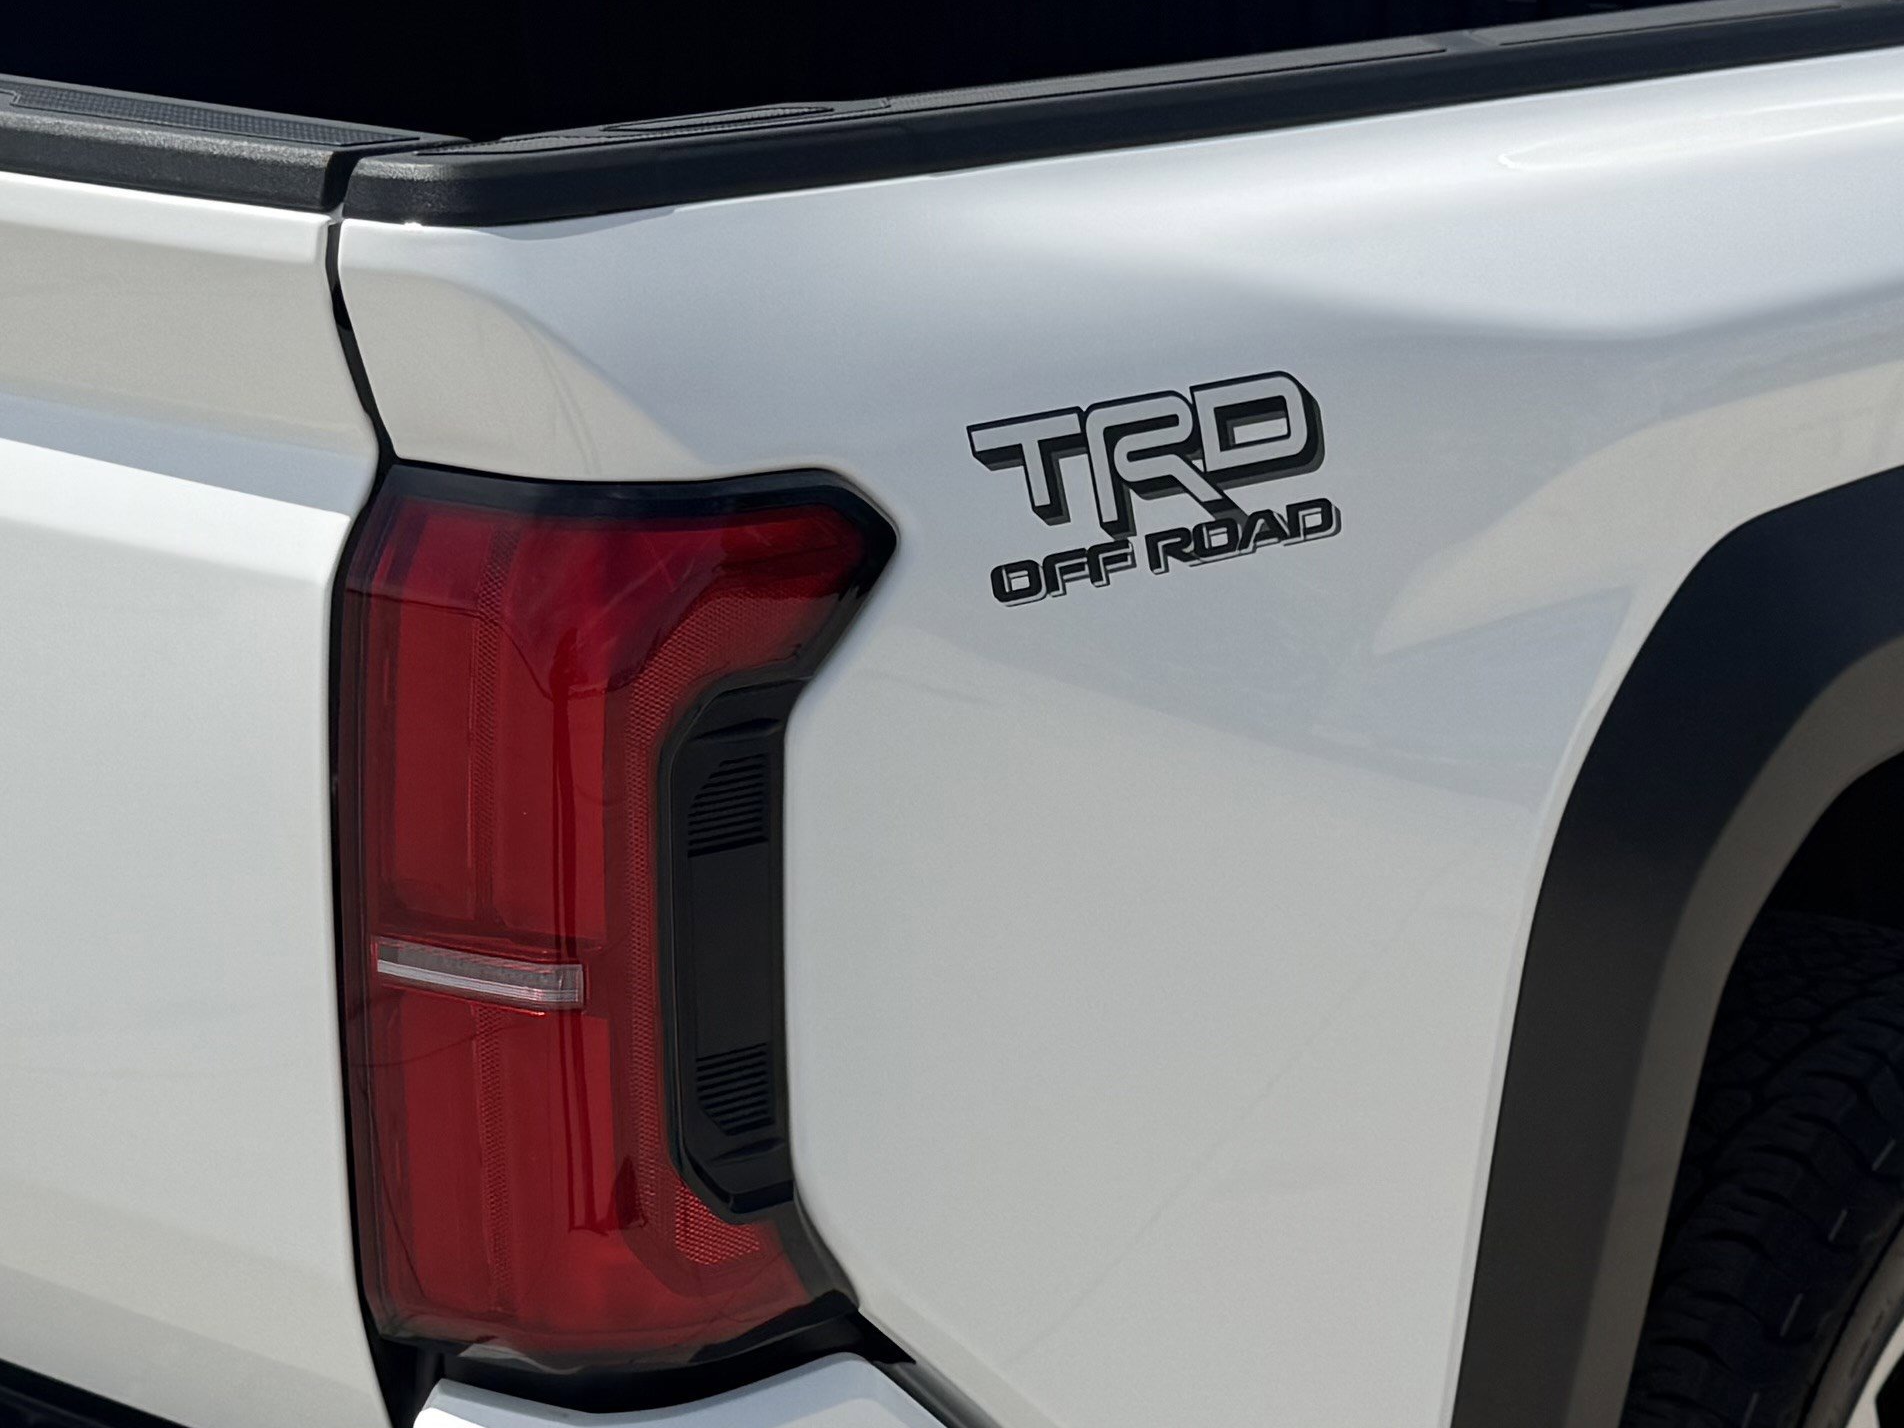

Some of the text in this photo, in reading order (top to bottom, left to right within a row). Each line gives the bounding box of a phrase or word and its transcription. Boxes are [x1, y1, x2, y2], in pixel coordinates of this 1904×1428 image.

[967, 370, 1325, 539] TRD
[990, 497, 1342, 607] OFF ROAD
